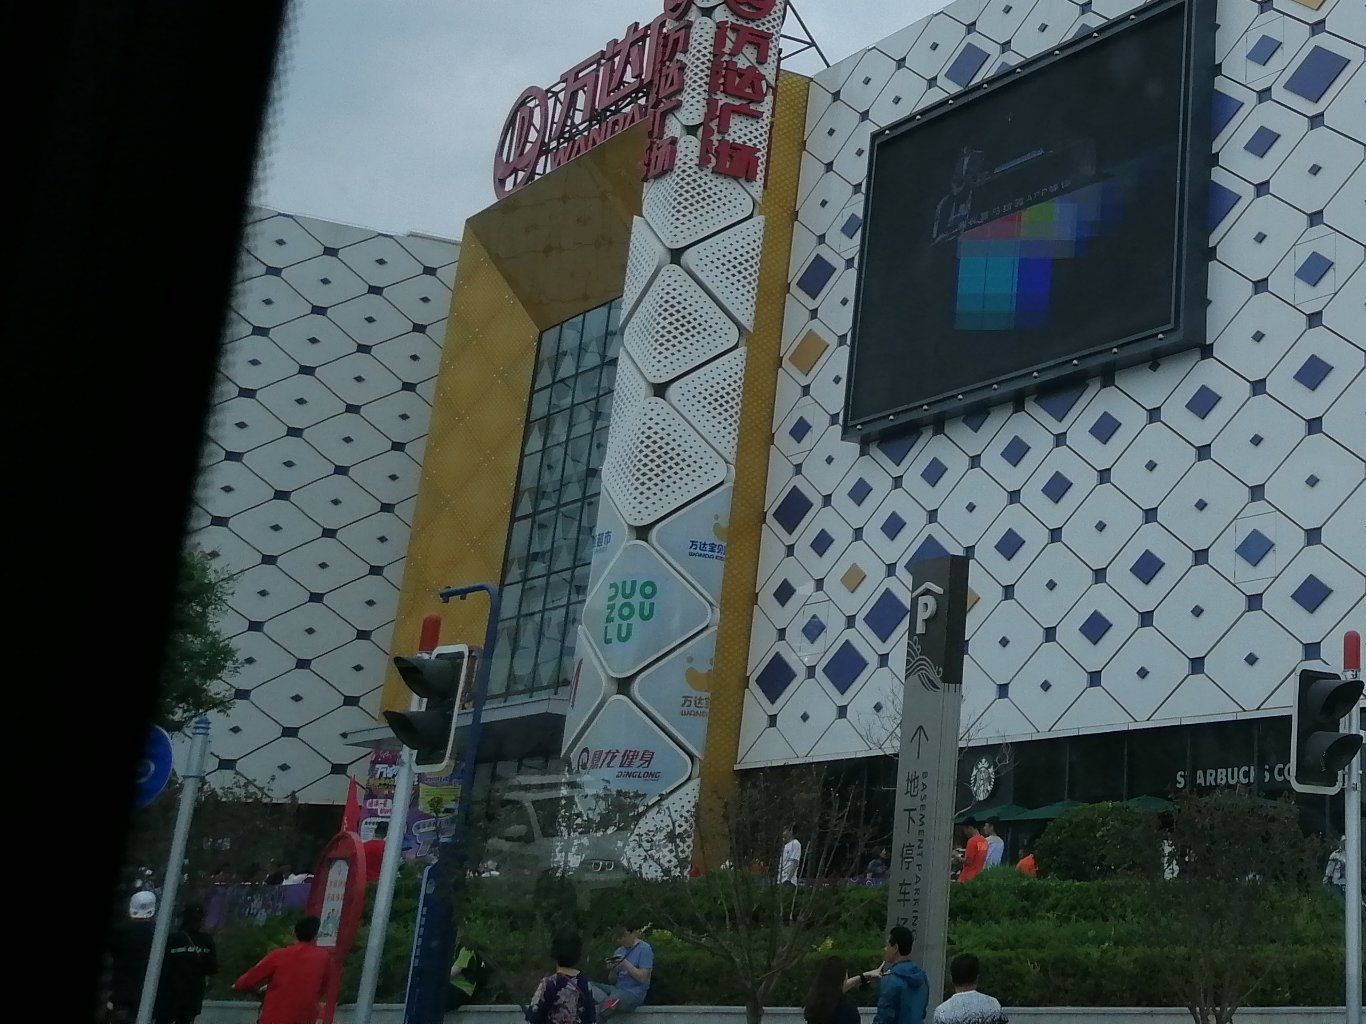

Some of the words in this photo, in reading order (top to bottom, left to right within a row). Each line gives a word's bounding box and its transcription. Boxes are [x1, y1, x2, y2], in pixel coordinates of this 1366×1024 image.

[688, 539, 727, 556] 万达宝贝
[605, 601, 655, 624] ZOU
[915, 595, 938, 635] P
[604, 623, 633, 645] LU
[916, 771, 929, 857] BASEMENT
[911, 863, 923, 941] PARKING
